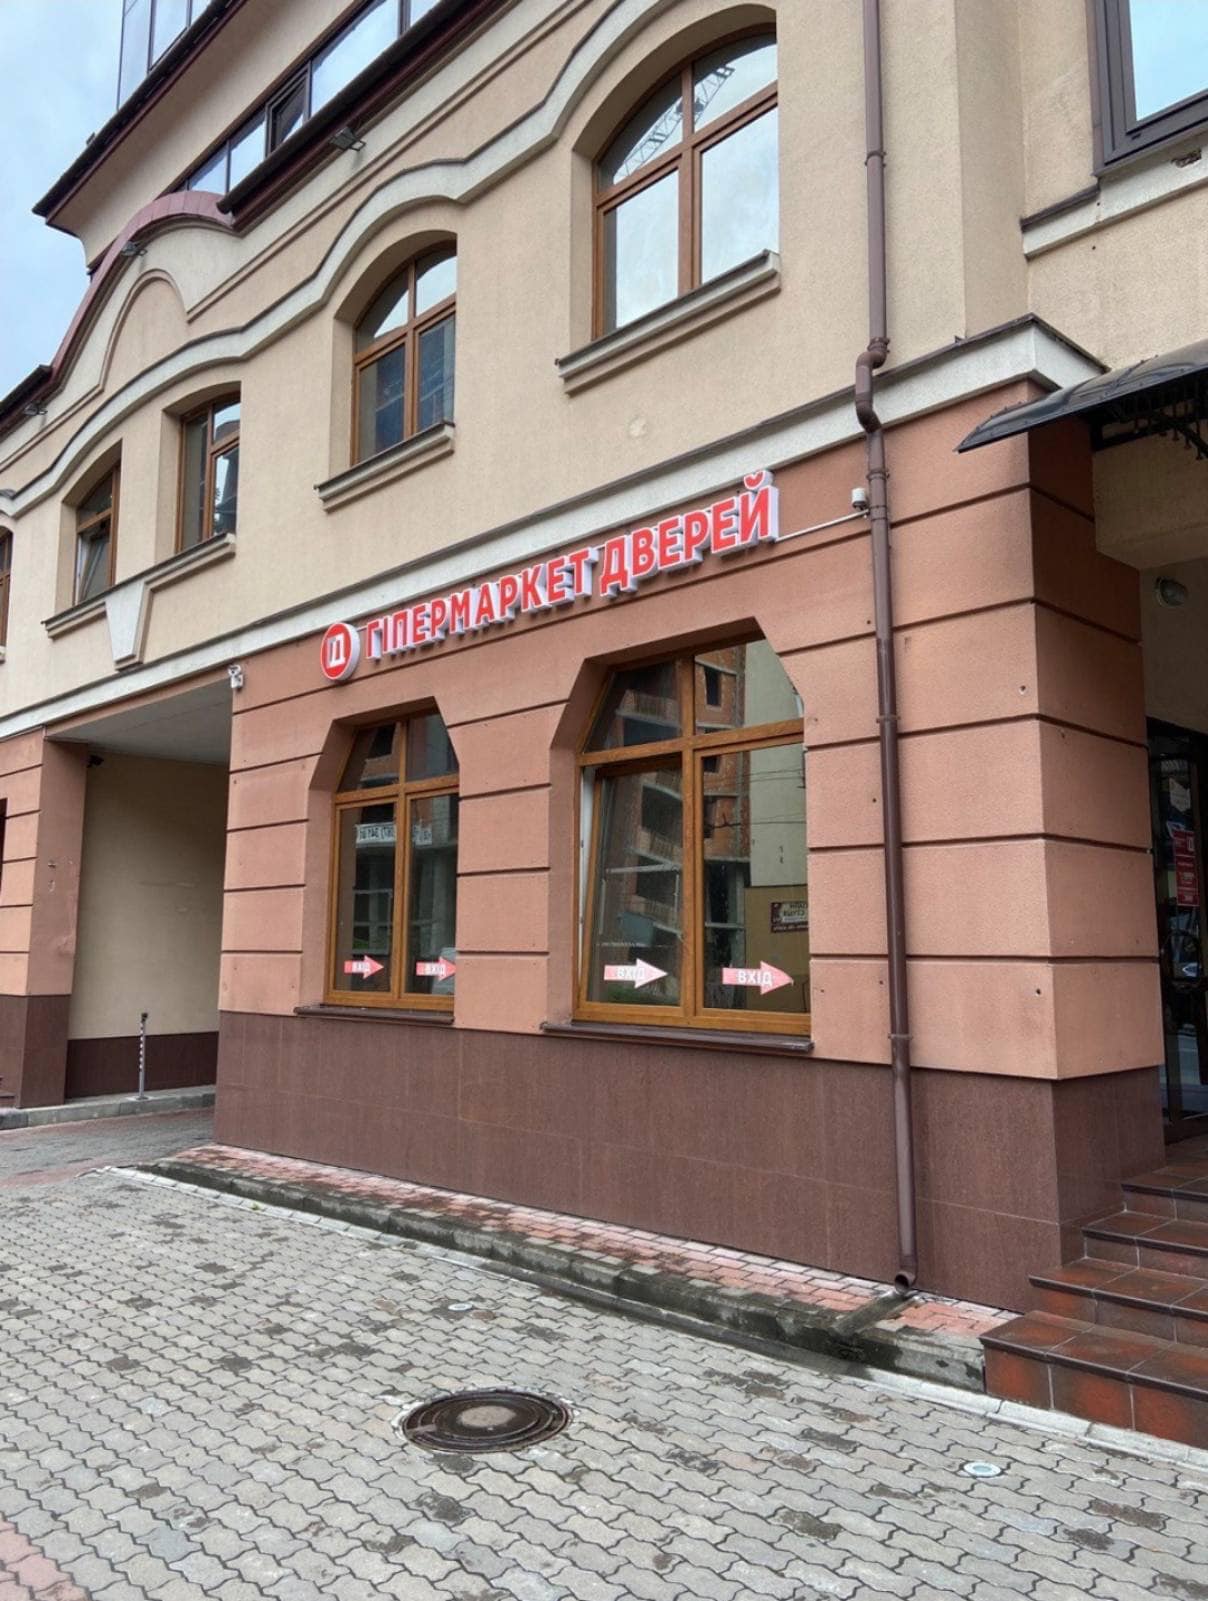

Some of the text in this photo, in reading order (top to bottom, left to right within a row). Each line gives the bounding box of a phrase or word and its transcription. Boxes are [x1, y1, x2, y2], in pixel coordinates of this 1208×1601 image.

[366, 471, 776, 660] ГІПЕРМАРКЕТ ДВЕРЕЙ
[737, 969, 773, 987] ВХІД
